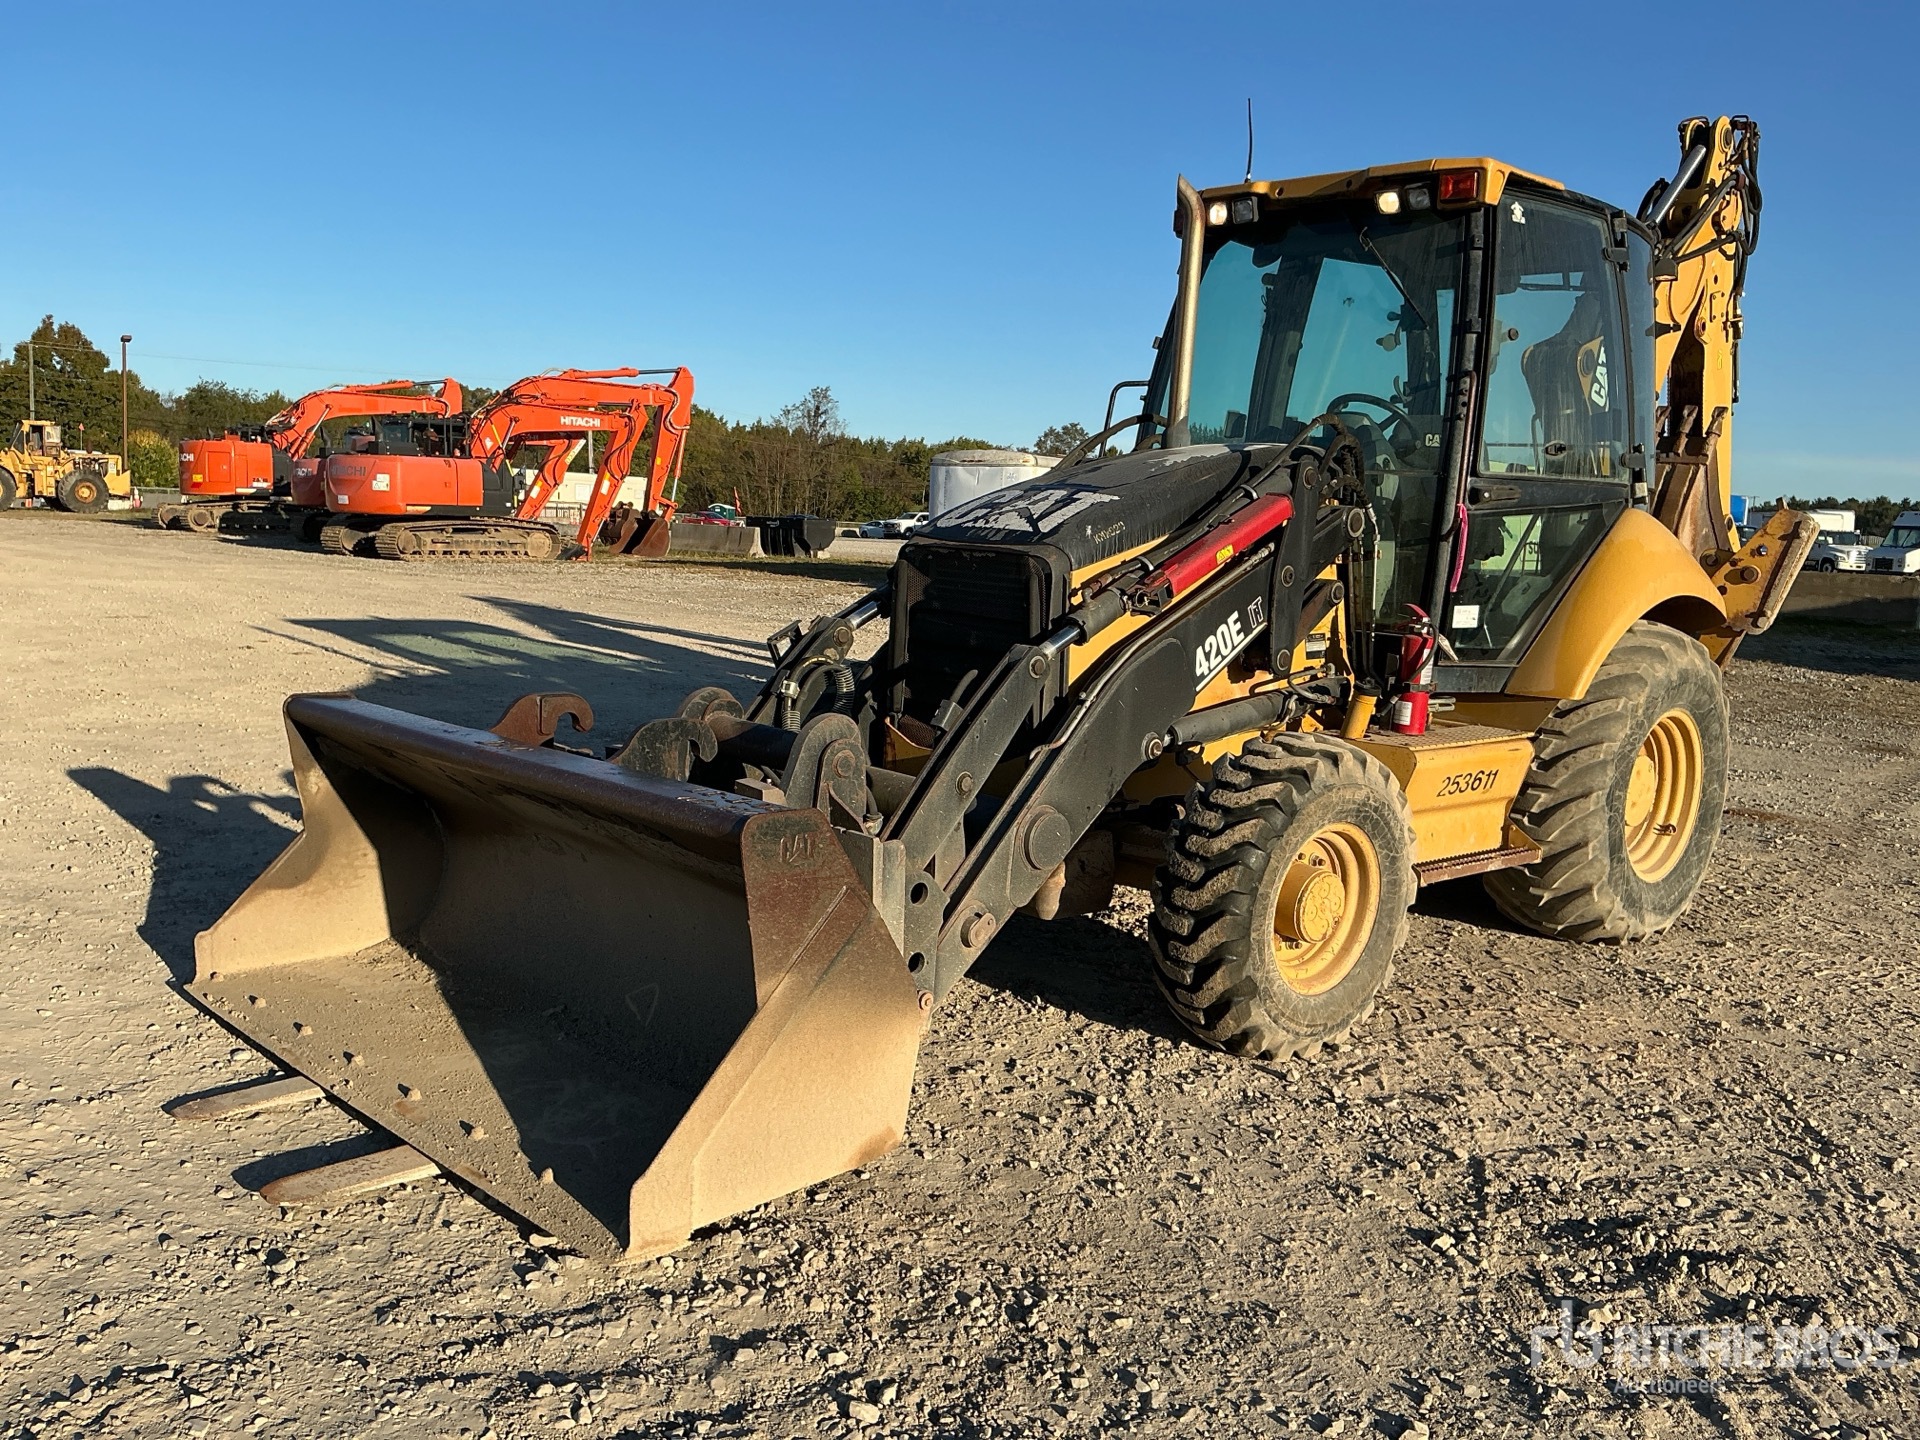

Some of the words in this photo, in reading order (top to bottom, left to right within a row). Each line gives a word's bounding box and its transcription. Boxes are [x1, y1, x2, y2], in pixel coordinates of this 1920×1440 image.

[560, 416, 600, 427] HITACHI
[1425, 433, 1441, 447] CA
[937, 489, 1120, 533] CAT
[1195, 610, 1245, 677] 420E
[1247, 595, 1264, 629] IT
[1436, 769, 1499, 797] 253611
